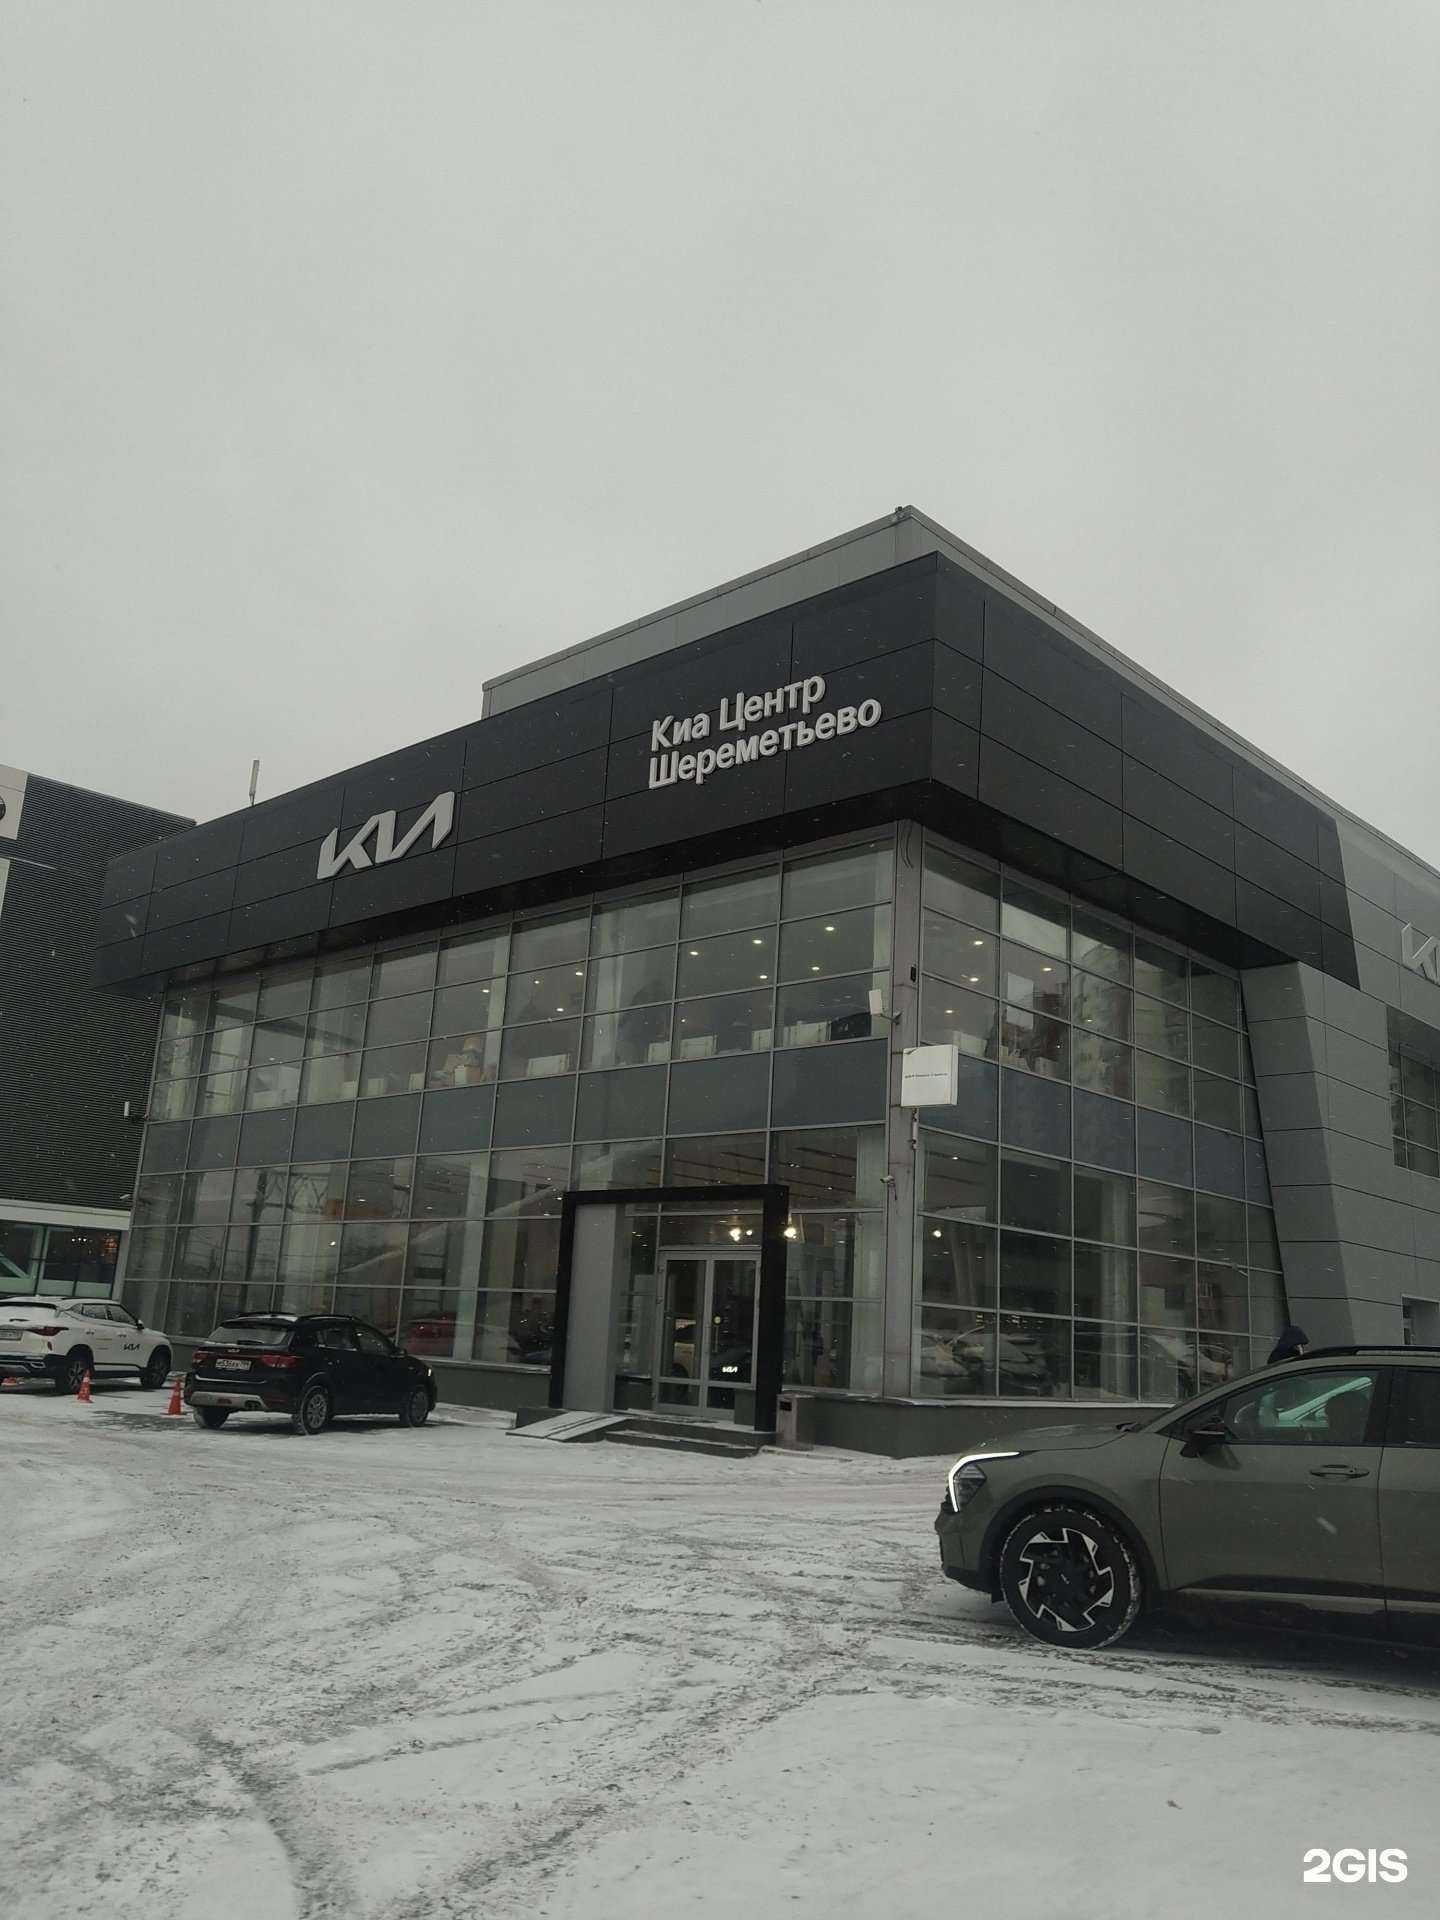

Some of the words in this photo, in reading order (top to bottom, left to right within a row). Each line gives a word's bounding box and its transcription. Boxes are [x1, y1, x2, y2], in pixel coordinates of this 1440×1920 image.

[649, 698, 882, 790] Шереметьево
[651, 713, 711, 752] Киа
[719, 675, 826, 732] Центр
[316, 791, 455, 880] KIA
